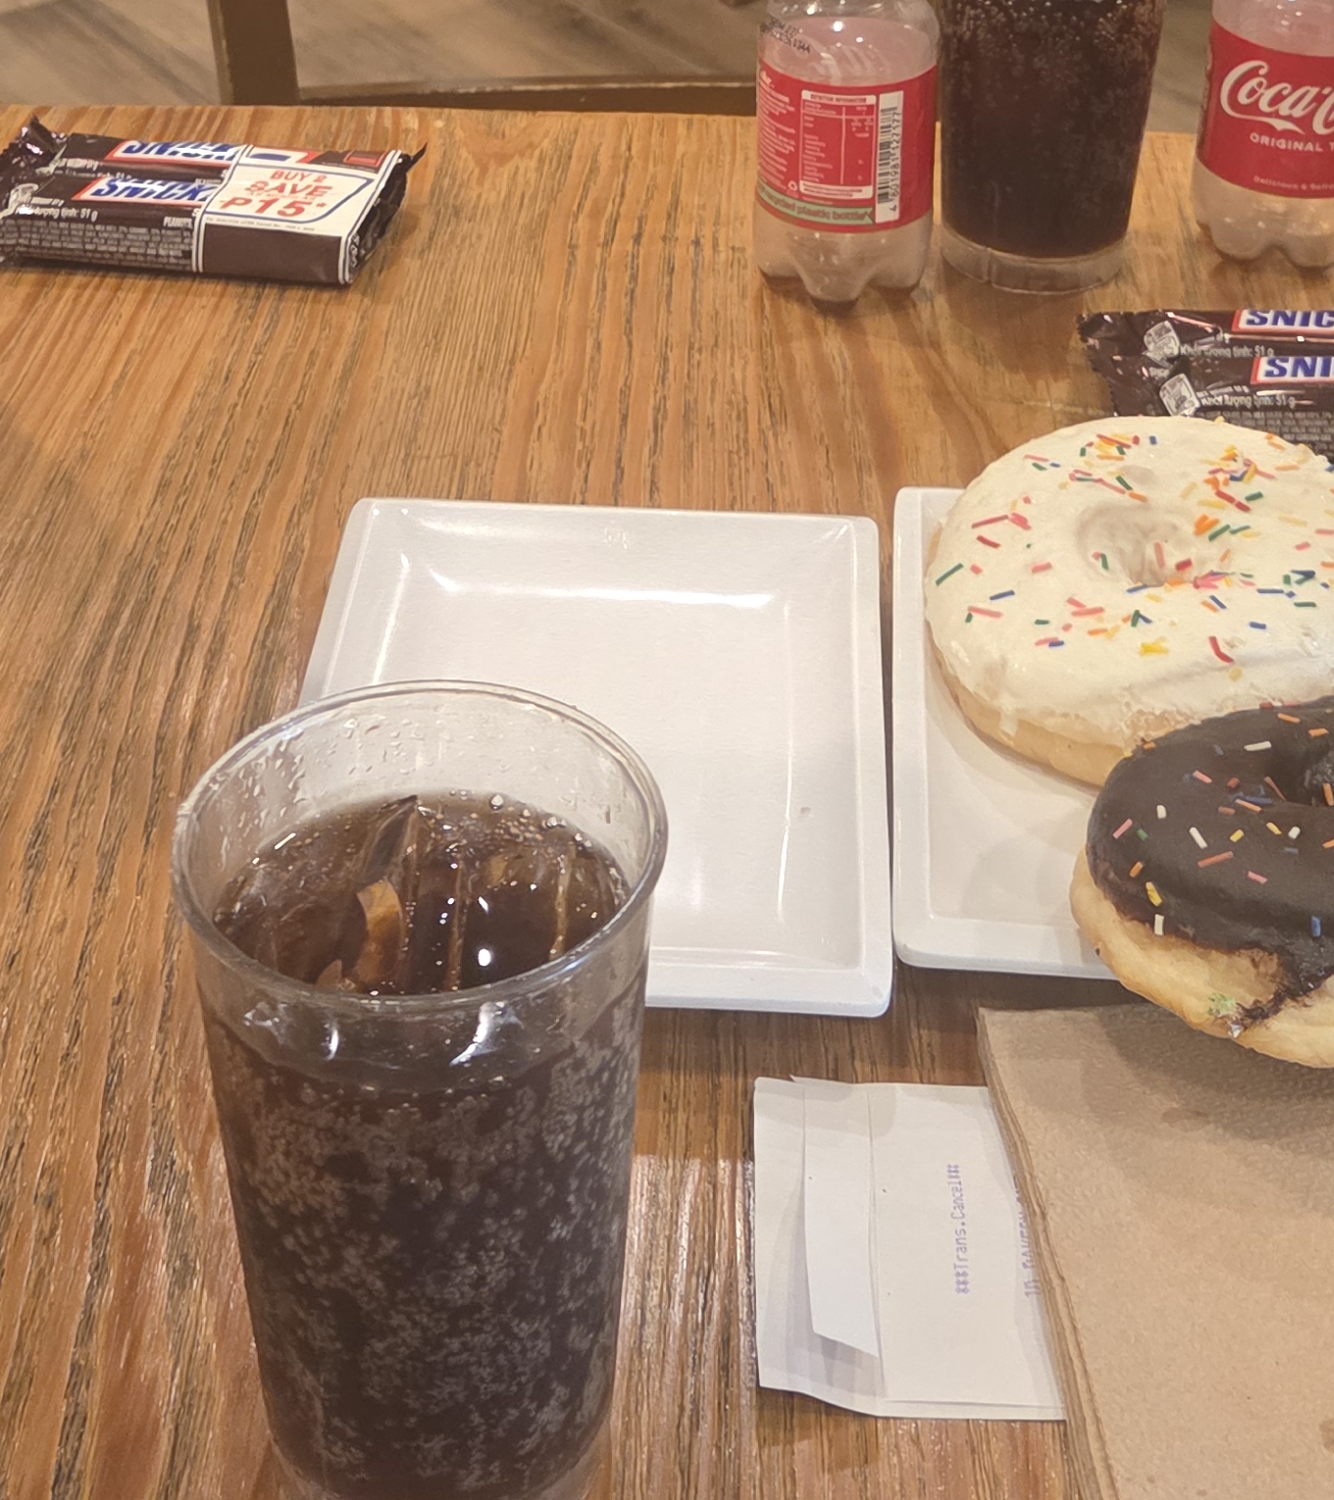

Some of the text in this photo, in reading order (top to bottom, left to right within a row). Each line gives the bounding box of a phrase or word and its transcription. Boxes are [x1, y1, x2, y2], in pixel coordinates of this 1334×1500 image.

[891, 111, 902, 150] 127177
[1249, 131, 1323, 152] ORIGINAL
[270, 169, 312, 182] BUY
[244, 180, 333, 197] SAVE
[1254, 345, 1265, 357] 51
[1276, 393, 1286, 406] 51
